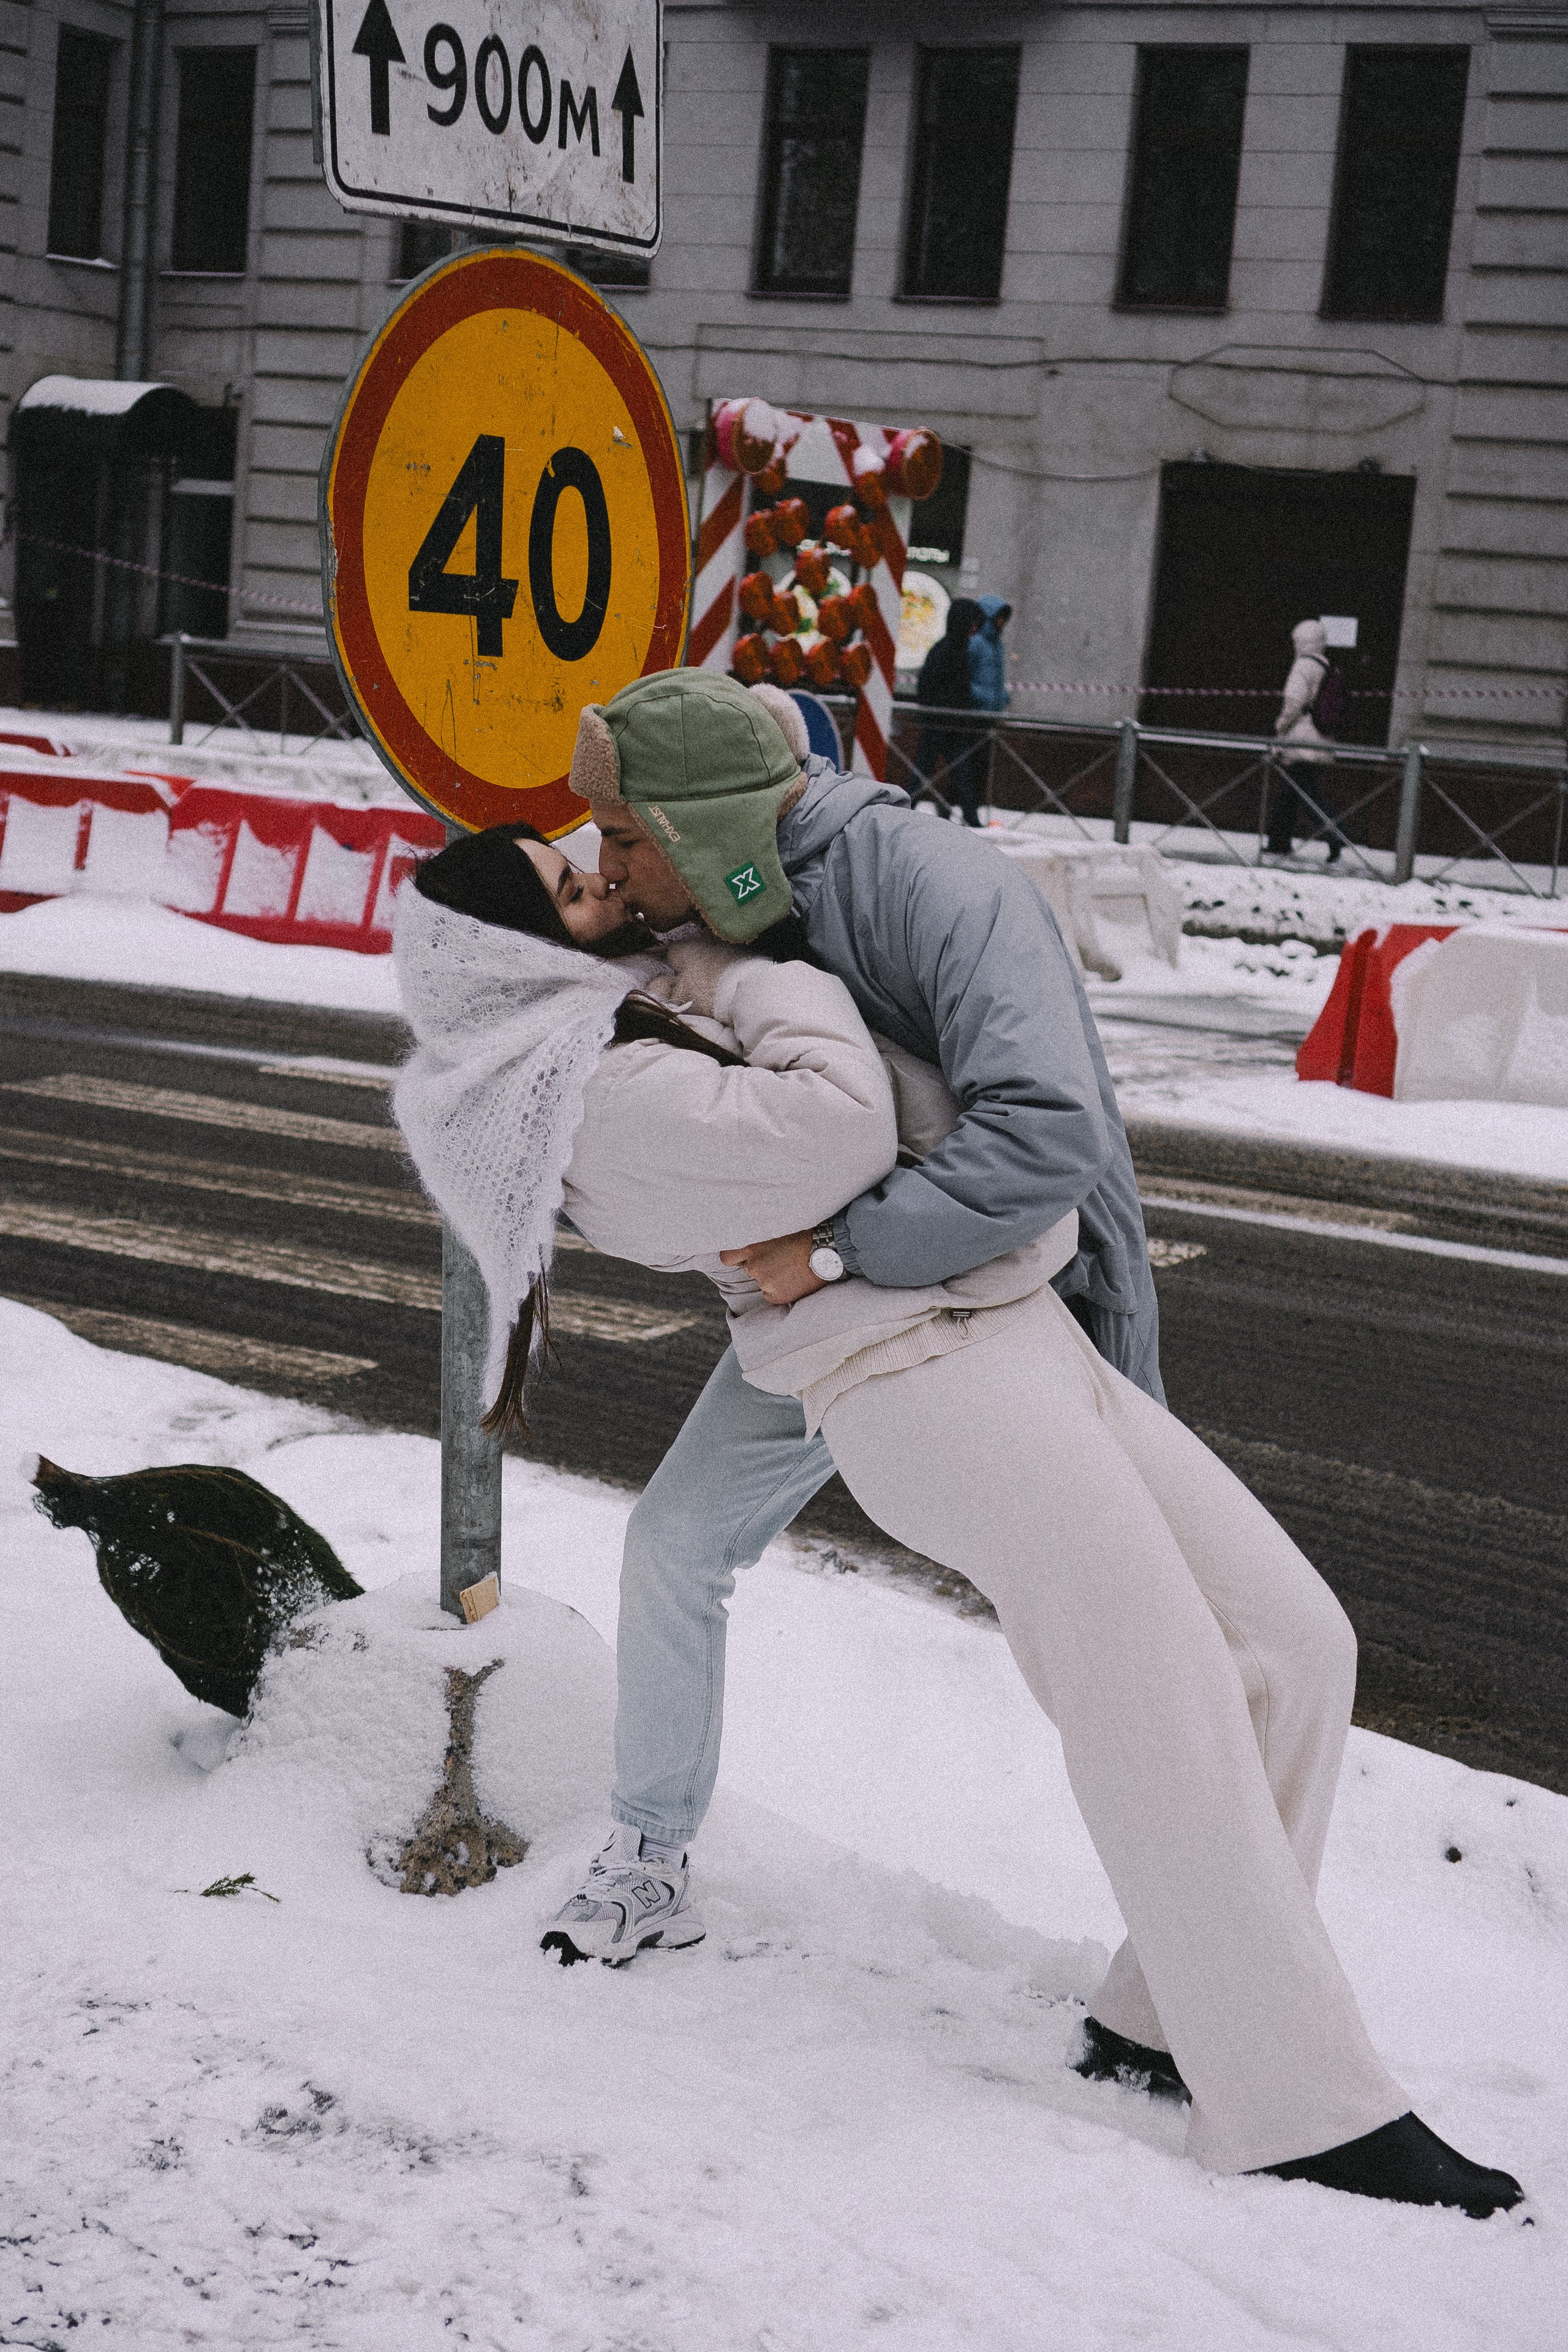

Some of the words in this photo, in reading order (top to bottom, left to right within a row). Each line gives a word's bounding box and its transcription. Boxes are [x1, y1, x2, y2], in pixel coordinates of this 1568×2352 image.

[409, 434, 612, 662] 40
[649, 805, 680, 842] EXHAUST
[731, 867, 761, 899] X
[632, 1880, 661, 1909] N
